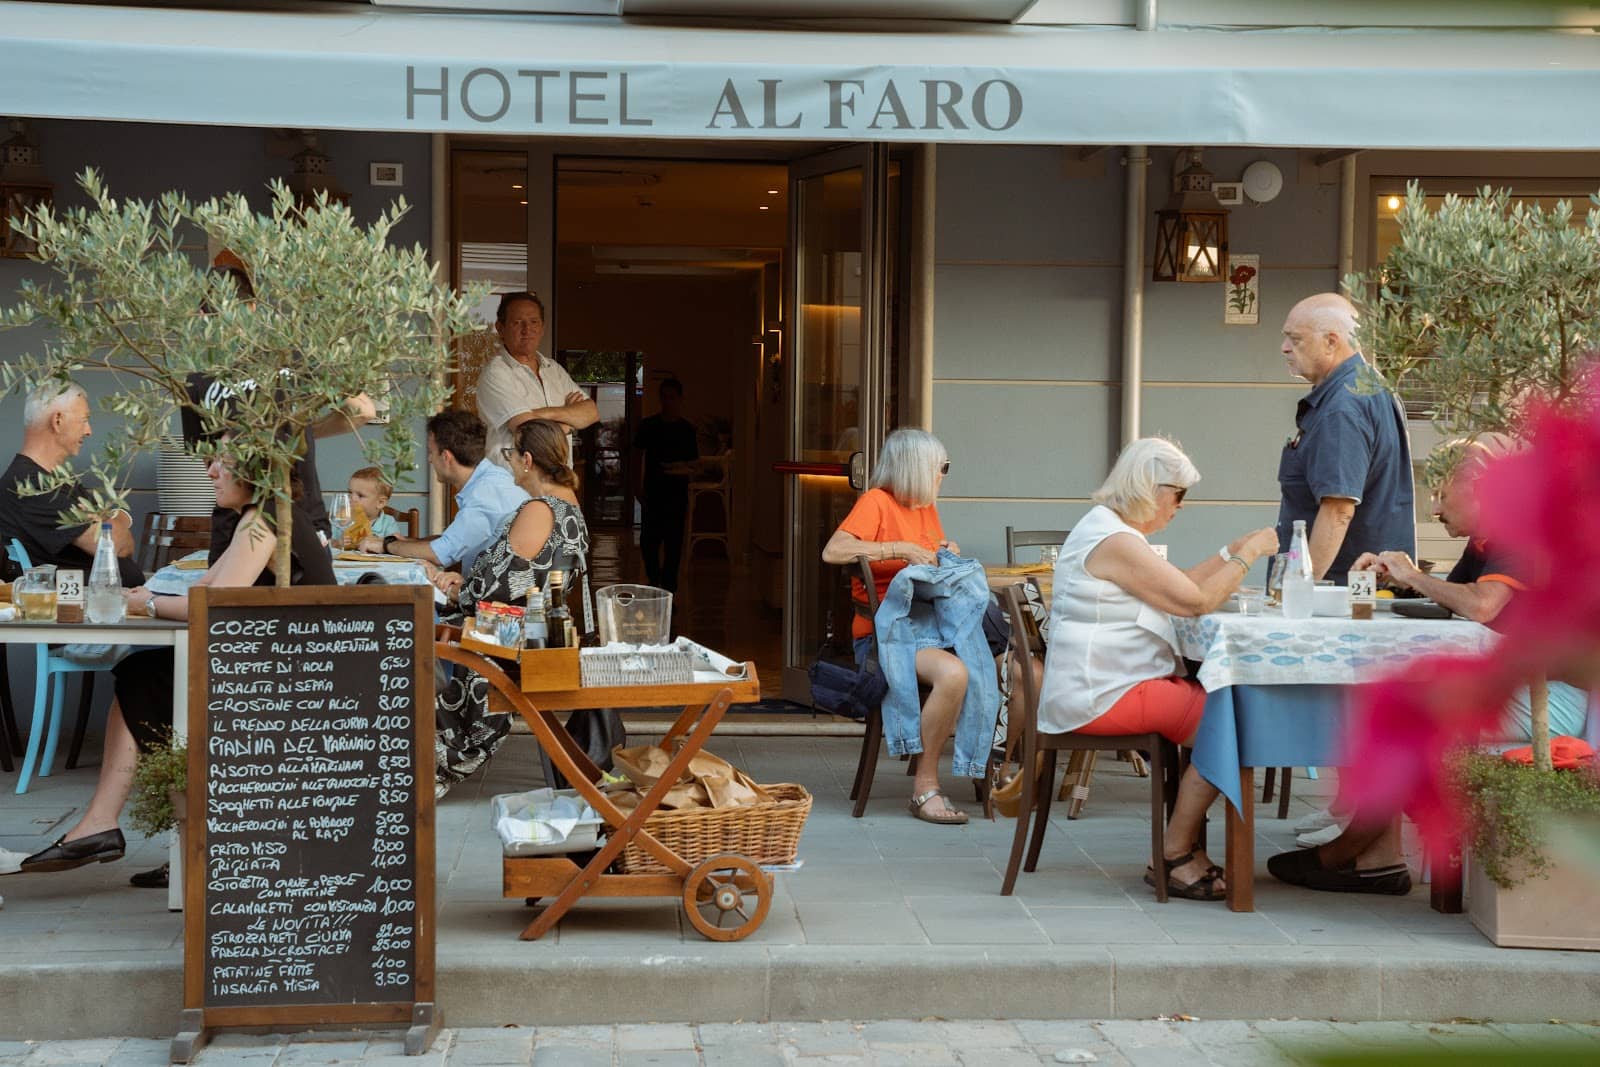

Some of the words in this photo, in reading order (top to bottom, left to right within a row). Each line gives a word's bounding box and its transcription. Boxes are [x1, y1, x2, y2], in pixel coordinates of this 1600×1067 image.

[405, 65, 654, 126] HOTEL
[705, 77, 803, 129] AL
[823, 78, 1024, 131] FARO
[60, 583, 79, 596] 23
[1351, 582, 1372, 595] 24
[210, 619, 279, 636] COZZE
[288, 622, 319, 635] ALLA
[208, 641, 263, 654] COZZE
[271, 641, 302, 654] ALLA
[211, 657, 273, 675] POLPETTE
[296, 699, 324, 710] CON
[232, 718, 286, 732] FREDDO
[289, 718, 331, 732] DELLA
[283, 737, 319, 754] DEL
[210, 763, 273, 778] RISOTTO
[278, 763, 308, 774] ALLA
[277, 797, 311, 810] ALLE
[292, 818, 306, 829] AL
[292, 830, 309, 840] AL
[319, 873, 365, 887] PESCE
[257, 888, 282, 899] CON
[211, 946, 260, 959] PADELLA
[278, 944, 350, 957] CROSTACEI
